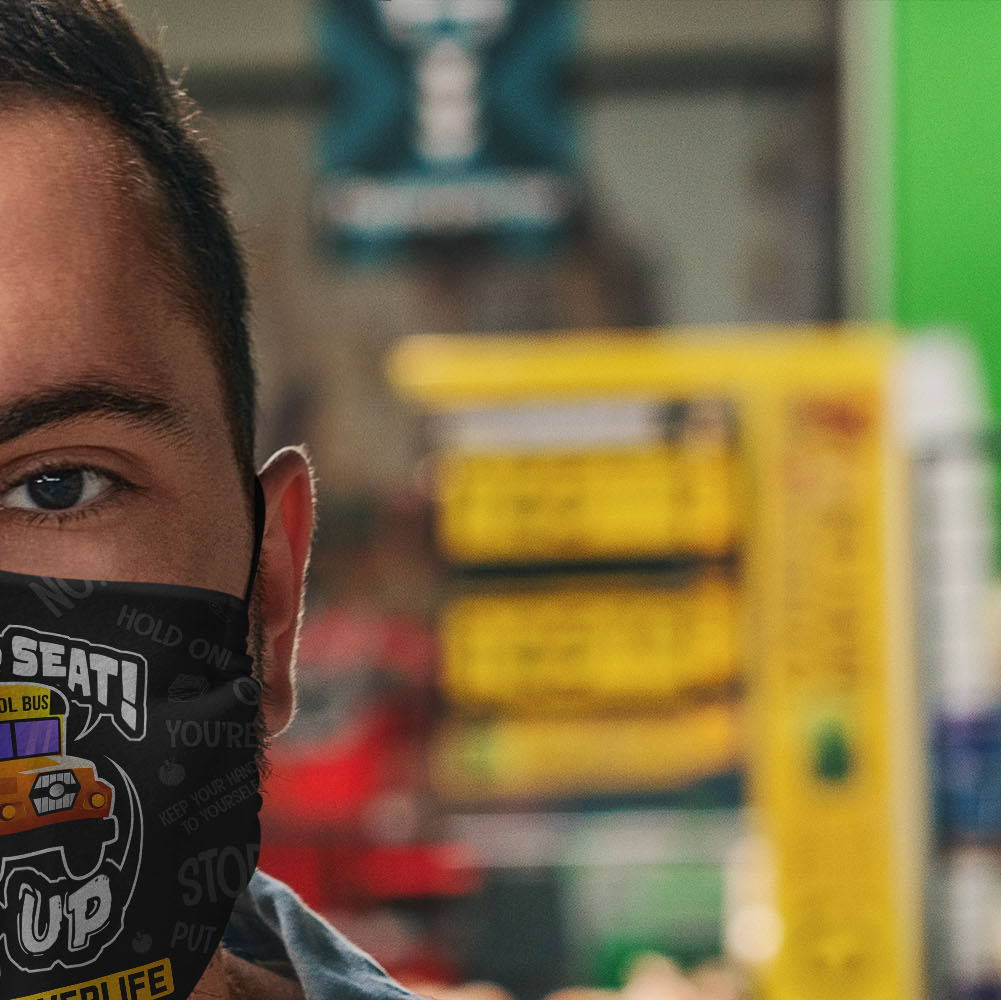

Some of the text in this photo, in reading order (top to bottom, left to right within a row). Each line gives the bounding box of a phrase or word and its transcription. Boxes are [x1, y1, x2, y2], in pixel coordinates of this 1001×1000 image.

[28, 577, 107, 619] NO
[117, 604, 233, 671] HOLD ON!
[11, 634, 139, 732] SEAT!
[22, 694, 50, 713] BUS
[164, 719, 258, 749] YOU'RE
[159, 799, 190, 827] KEEP
[190, 778, 227, 806] YOUR
[180, 816, 200, 836] TO
[16, 874, 112, 958] UP
[170, 920, 217, 954] PUT
